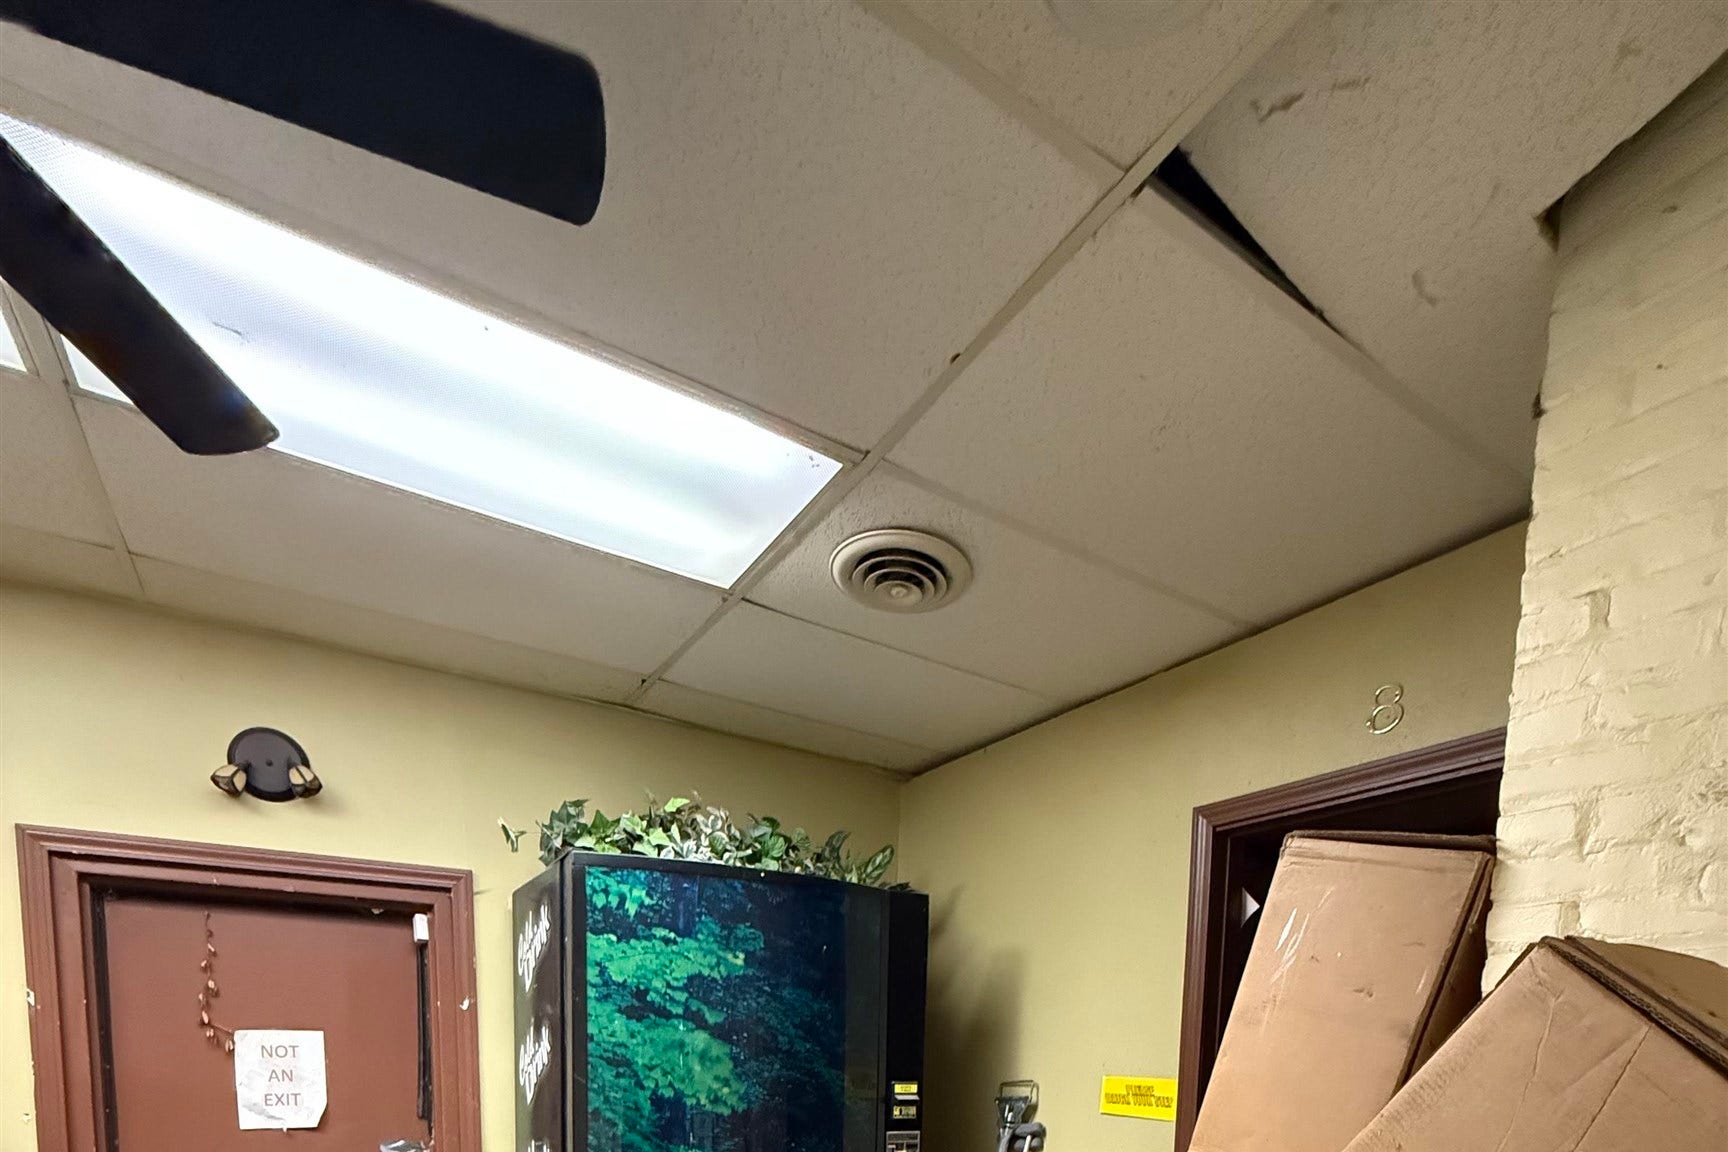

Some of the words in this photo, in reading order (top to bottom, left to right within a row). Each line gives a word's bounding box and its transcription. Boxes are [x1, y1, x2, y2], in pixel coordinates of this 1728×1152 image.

[1366, 683, 1404, 735] 8
[525, 904, 551, 992] Drink
[261, 1045, 299, 1059] NOT
[526, 1026, 551, 1105] Drink
[268, 1069, 293, 1082] AN
[264, 1093, 301, 1107] EXIT
